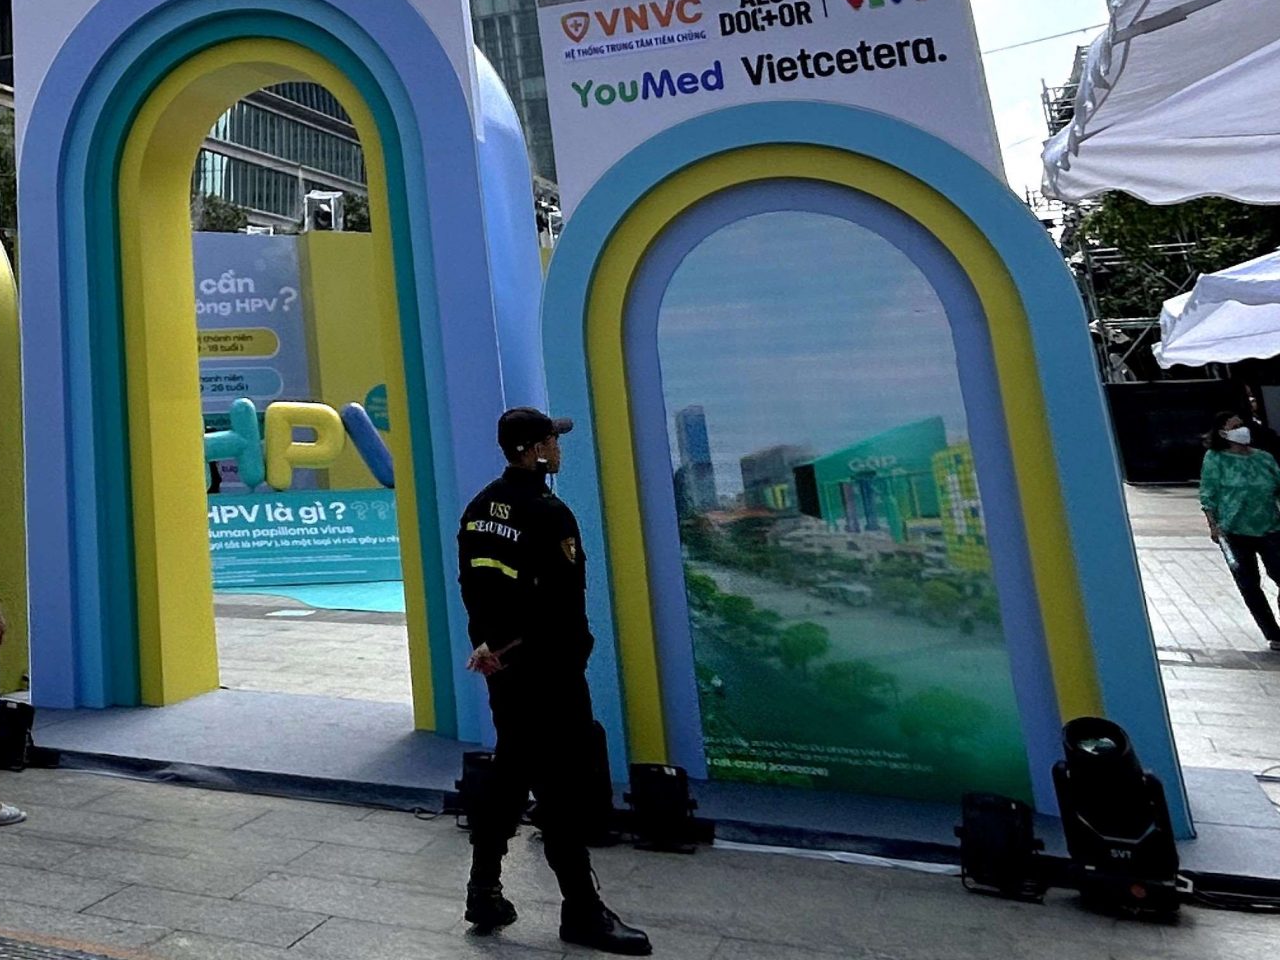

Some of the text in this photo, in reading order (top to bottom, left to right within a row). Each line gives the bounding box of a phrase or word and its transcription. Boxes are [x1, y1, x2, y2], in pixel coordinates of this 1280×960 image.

[565, 30, 707, 59] HỆ THỐNG TRUNG TÂM TIÊM CHỦNG
[571, 37, 948, 109] YouMed Vietcetera.
[199, 269, 256, 294] cần
[235, 297, 278, 313] HPV
[265, 501, 293, 523] là
[299, 500, 326, 524] gì
[489, 501, 512, 520] USS
[252, 526, 319, 539] papilloma
[320, 525, 355, 535] virus
[474, 520, 522, 542] SECURITY
[252, 540, 272, 548] HPV
